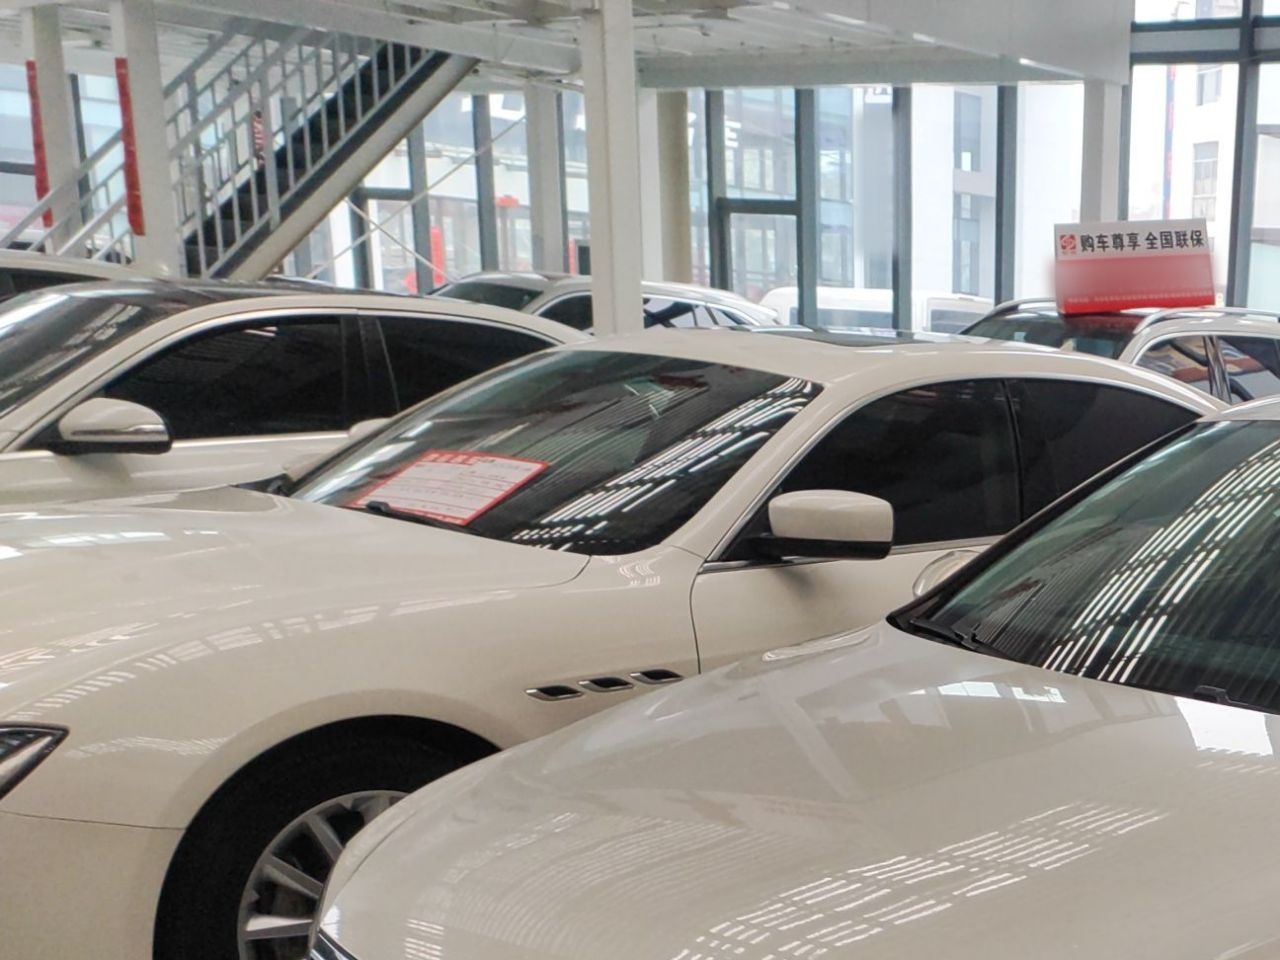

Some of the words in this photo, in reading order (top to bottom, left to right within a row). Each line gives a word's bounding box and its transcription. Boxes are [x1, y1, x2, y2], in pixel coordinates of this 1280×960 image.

[1080, 232, 1141, 252] 购车尊享
[1145, 230, 1205, 250] 全国联保
